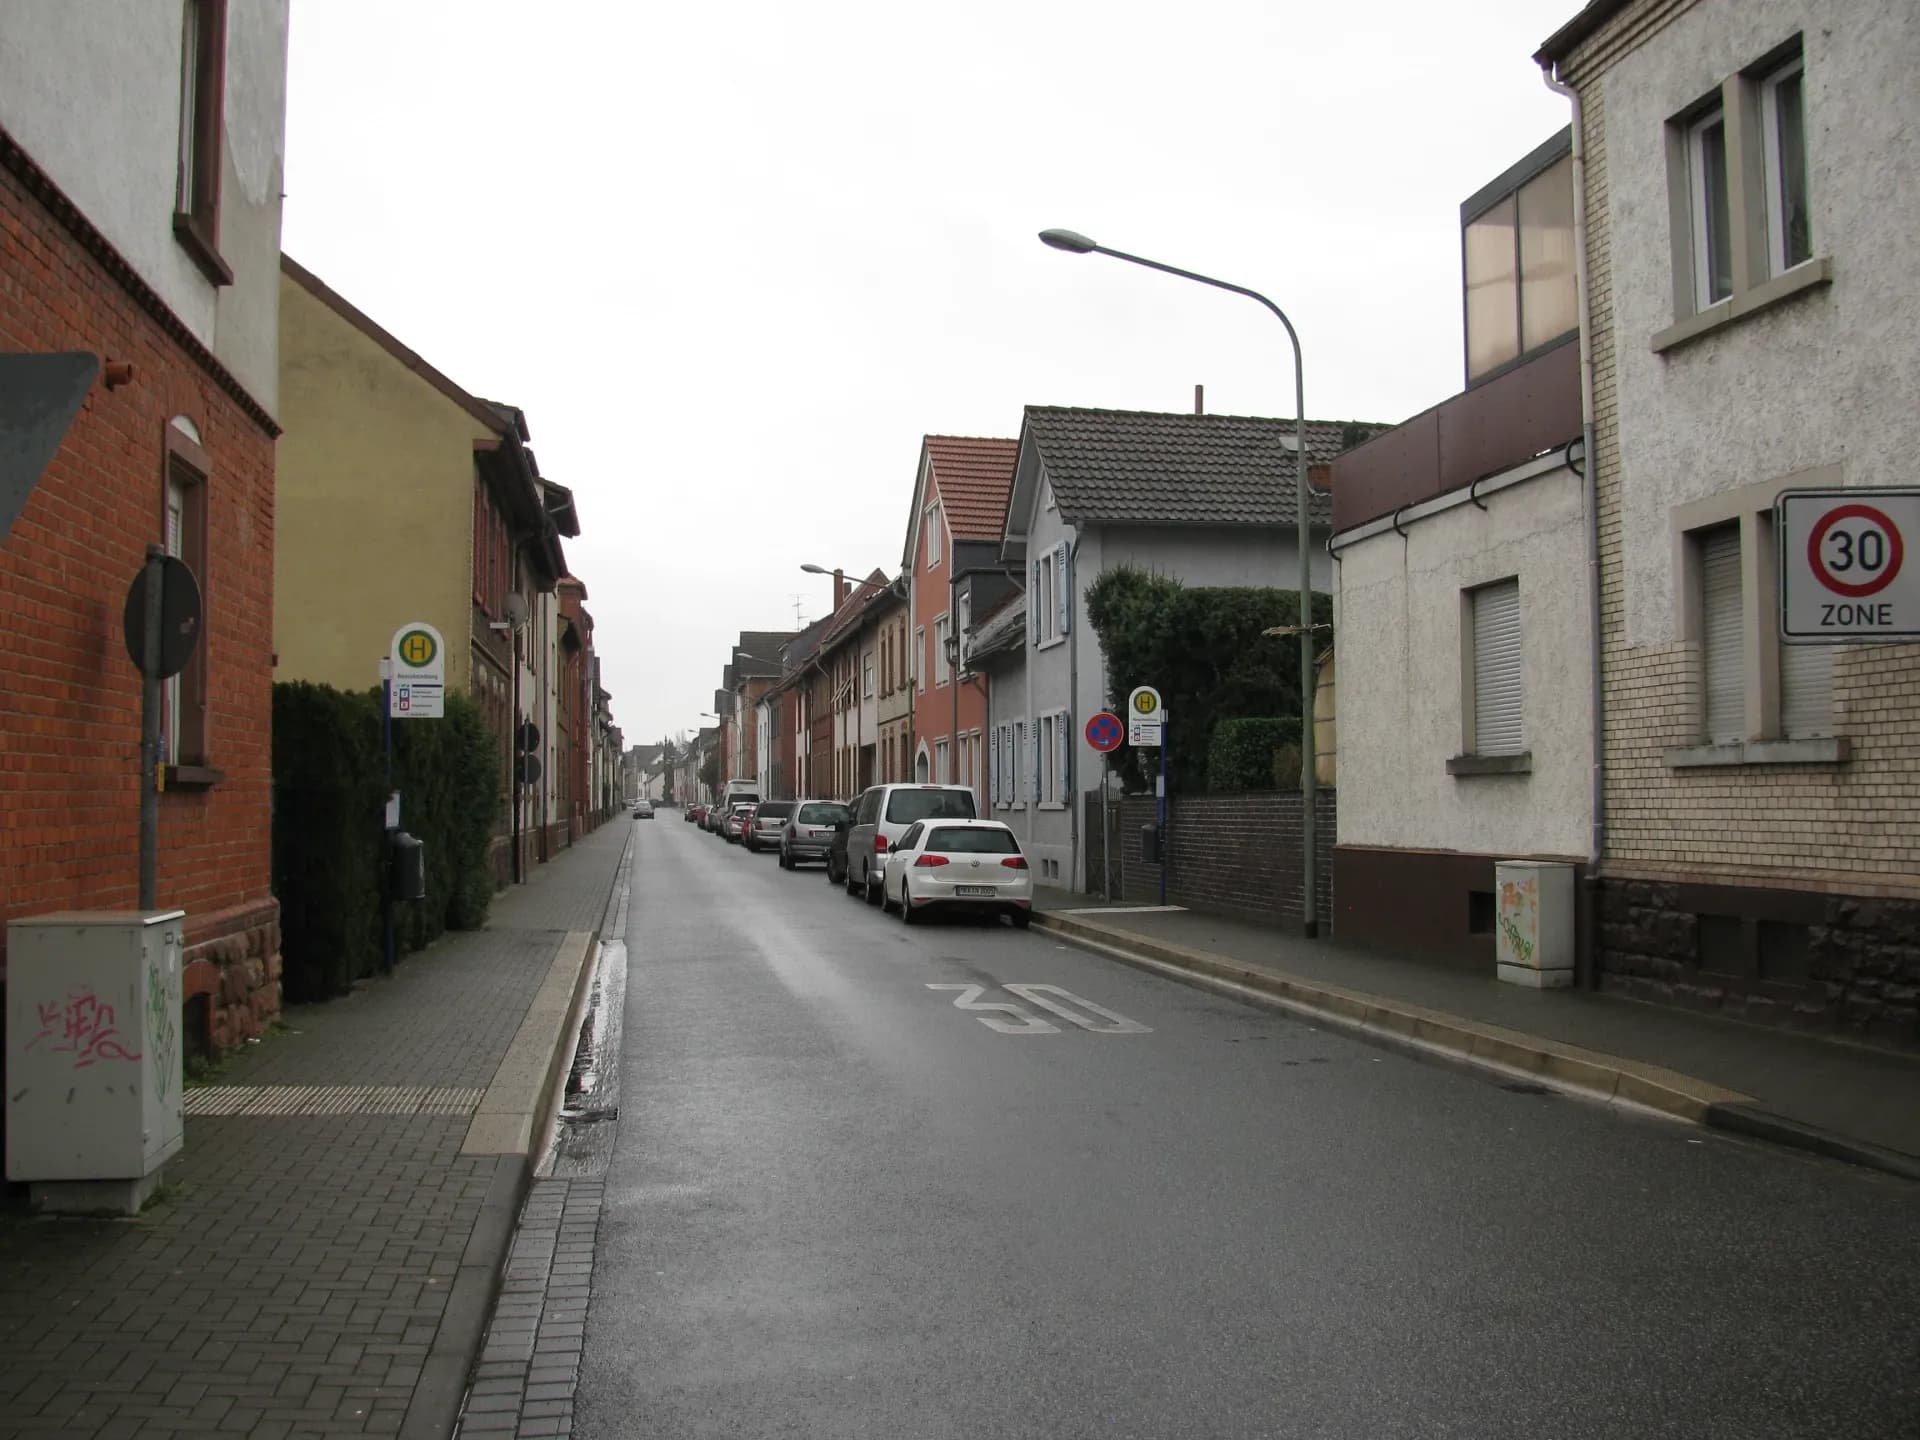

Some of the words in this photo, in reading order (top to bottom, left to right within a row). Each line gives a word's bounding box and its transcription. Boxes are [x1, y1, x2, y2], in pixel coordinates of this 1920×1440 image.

[1829, 530, 1883, 572] 30
[1820, 604, 1893, 626] ZONE
[410, 639, 425, 659] H
[1140, 696, 1150, 709] H
[925, 983, 1154, 1034] 30
